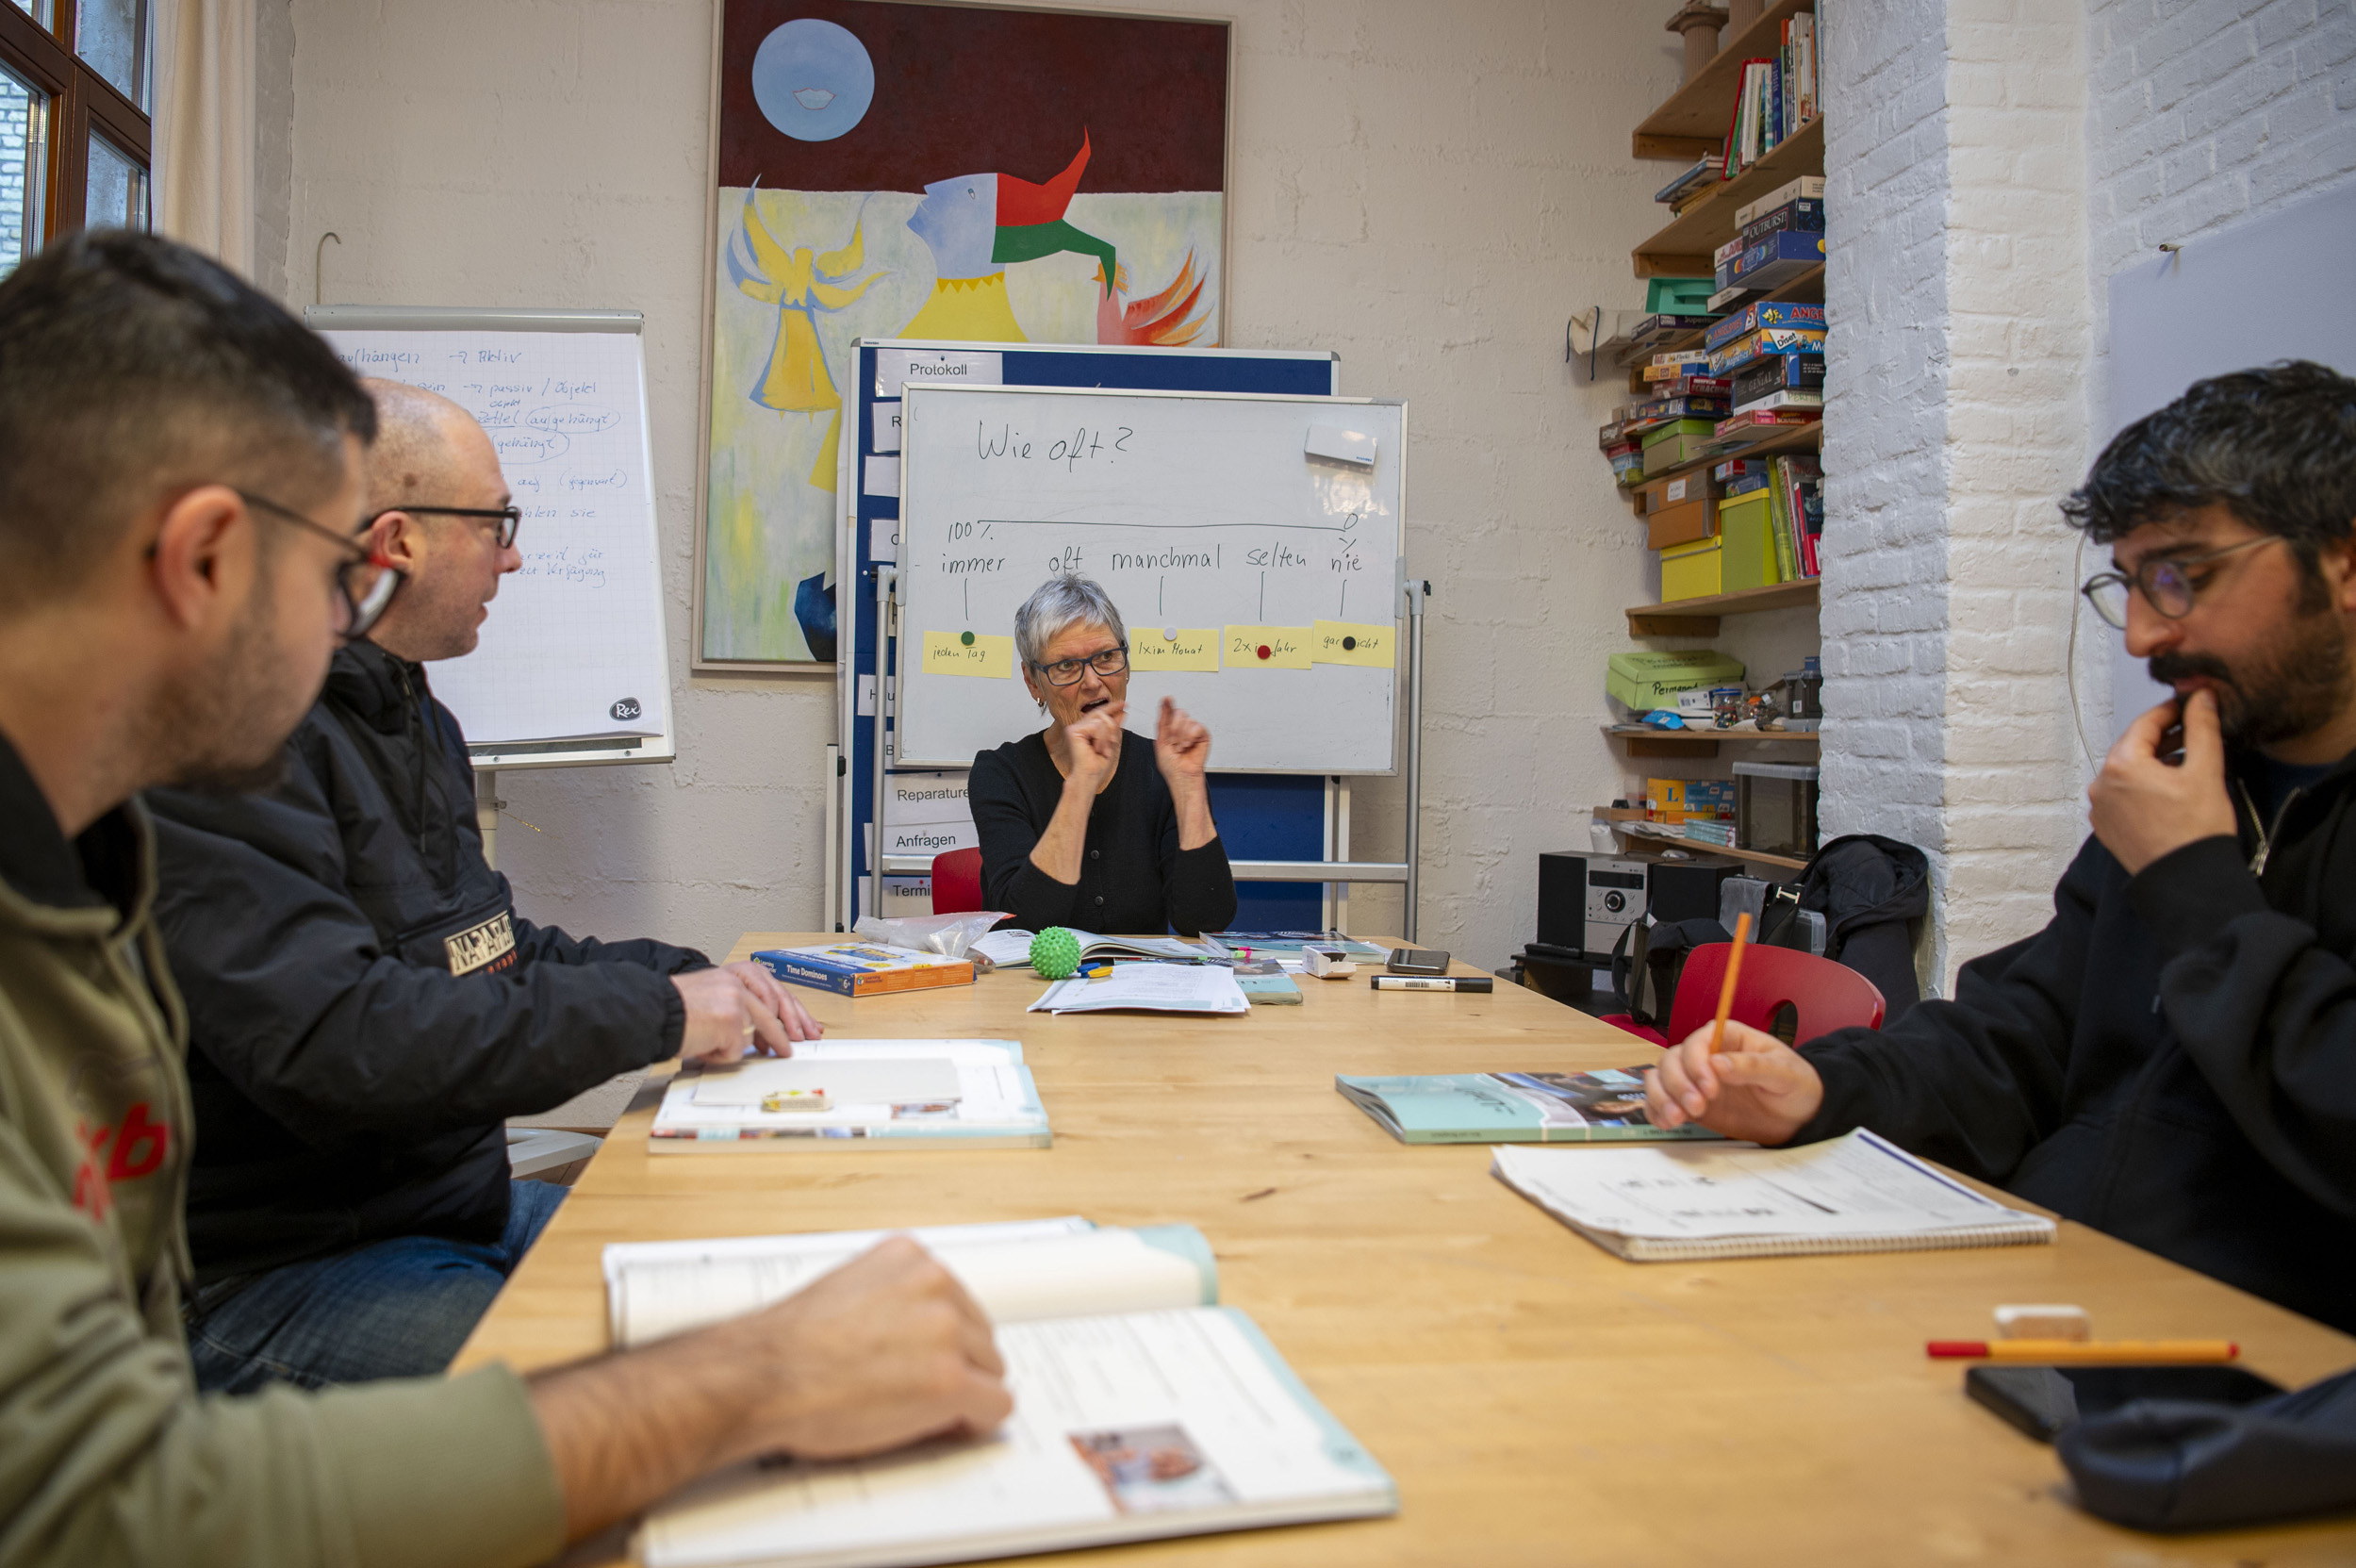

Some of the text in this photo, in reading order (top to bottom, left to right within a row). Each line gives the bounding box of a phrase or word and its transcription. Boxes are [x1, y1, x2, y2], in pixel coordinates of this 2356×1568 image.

[1750, 210, 1788, 239] OUTBURST!
[1790, 306, 1825, 321] ANGE
[910, 363, 967, 376] Protokoll
[489, 383, 534, 397] passiv
[977, 420, 1134, 472] Wie oft?
[1343, 513, 1359, 530] 0
[942, 541, 1362, 575] immer oft manchmal selten nie
[1171, 642, 1203, 655] Monat
[1323, 635, 1379, 650] gar icht
[932, 645, 986, 662] jeden Tag
[1652, 681, 1698, 696] Perman
[615, 701, 640, 718] Rex
[897, 787, 969, 802] Reparature
[896, 834, 956, 849] Anfragen
[893, 884, 931, 898] Termi
[786, 964, 800, 975] Time
[800, 966, 828, 982] Dominoes
